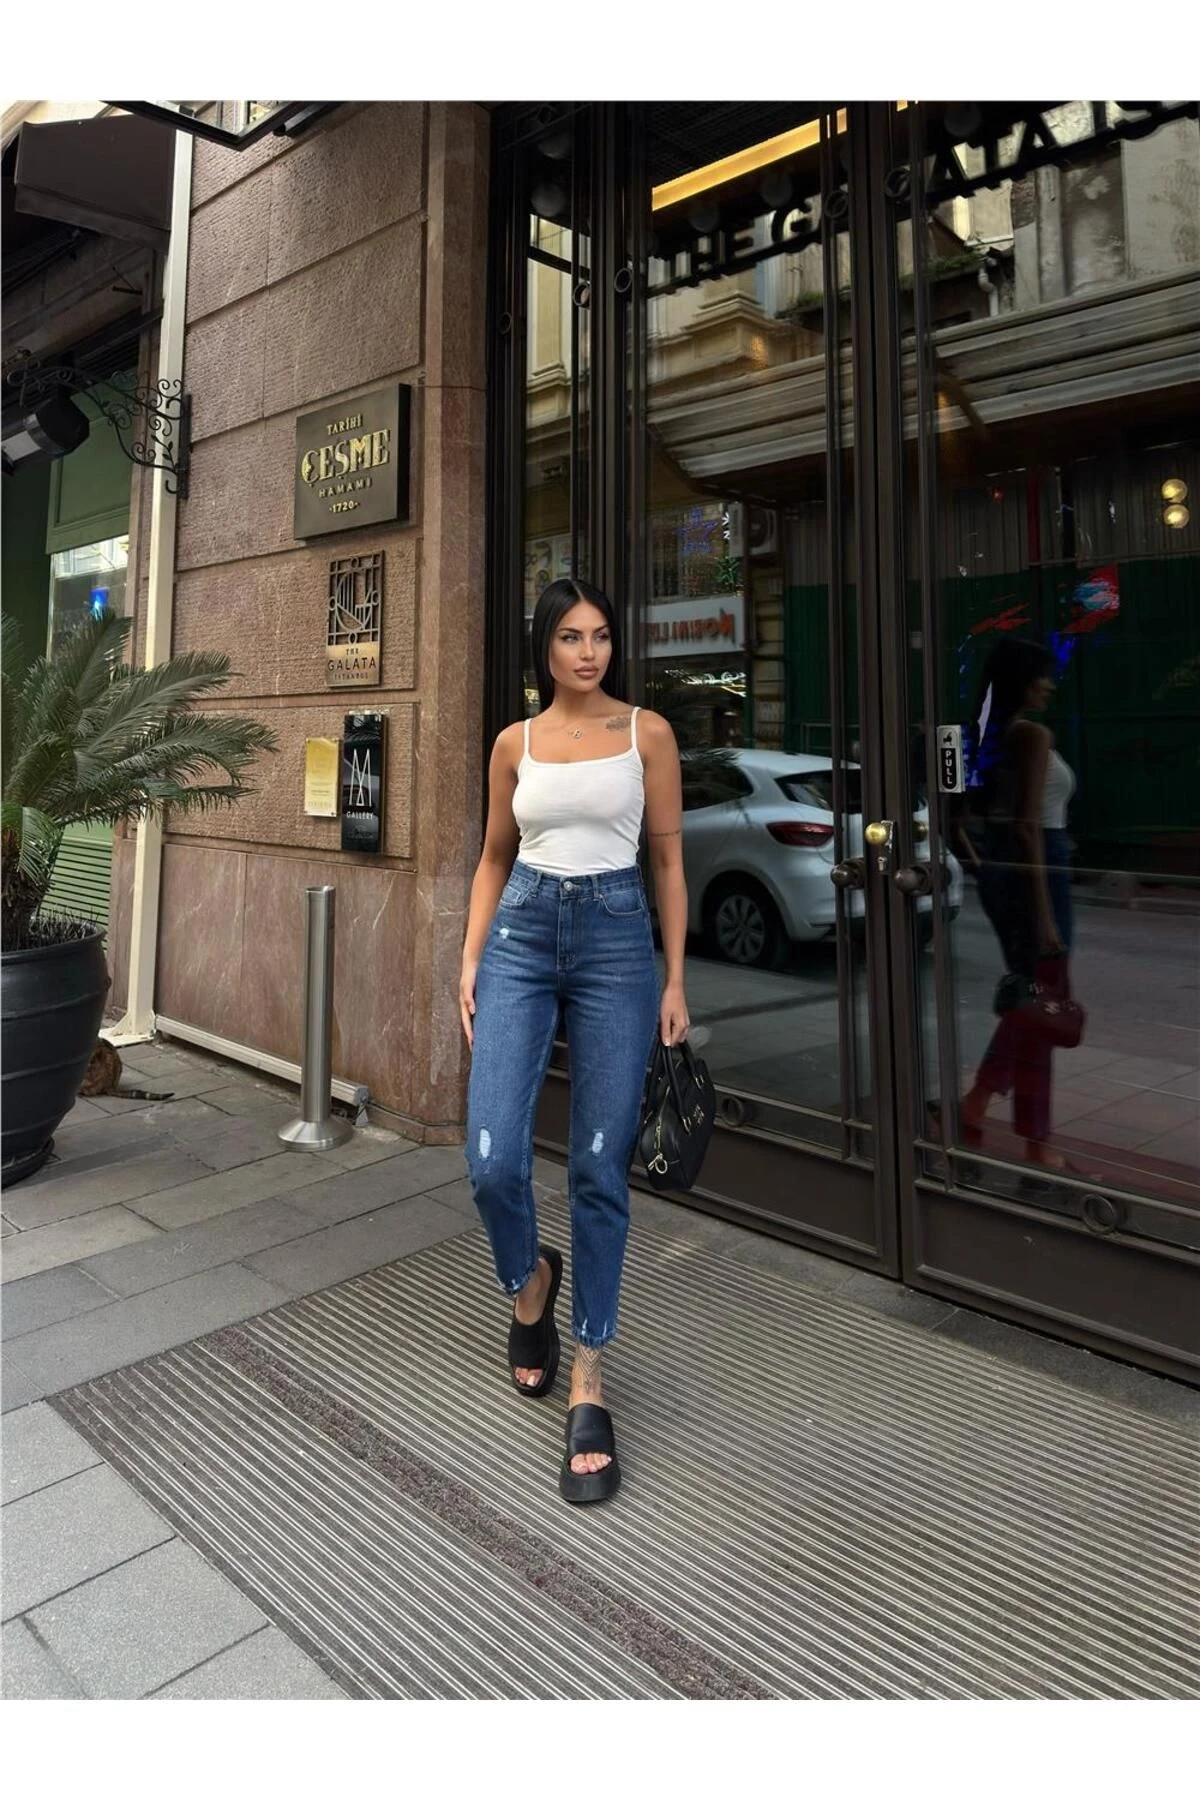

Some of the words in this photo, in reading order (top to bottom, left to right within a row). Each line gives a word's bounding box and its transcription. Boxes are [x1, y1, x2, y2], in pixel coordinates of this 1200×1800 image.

[301, 428, 391, 487] ÇEŞME
[345, 647, 359, 656] THE
[327, 656, 377, 671] GALATA
[945, 749, 953, 785] PULL
[346, 810, 374, 820] GALLERY
